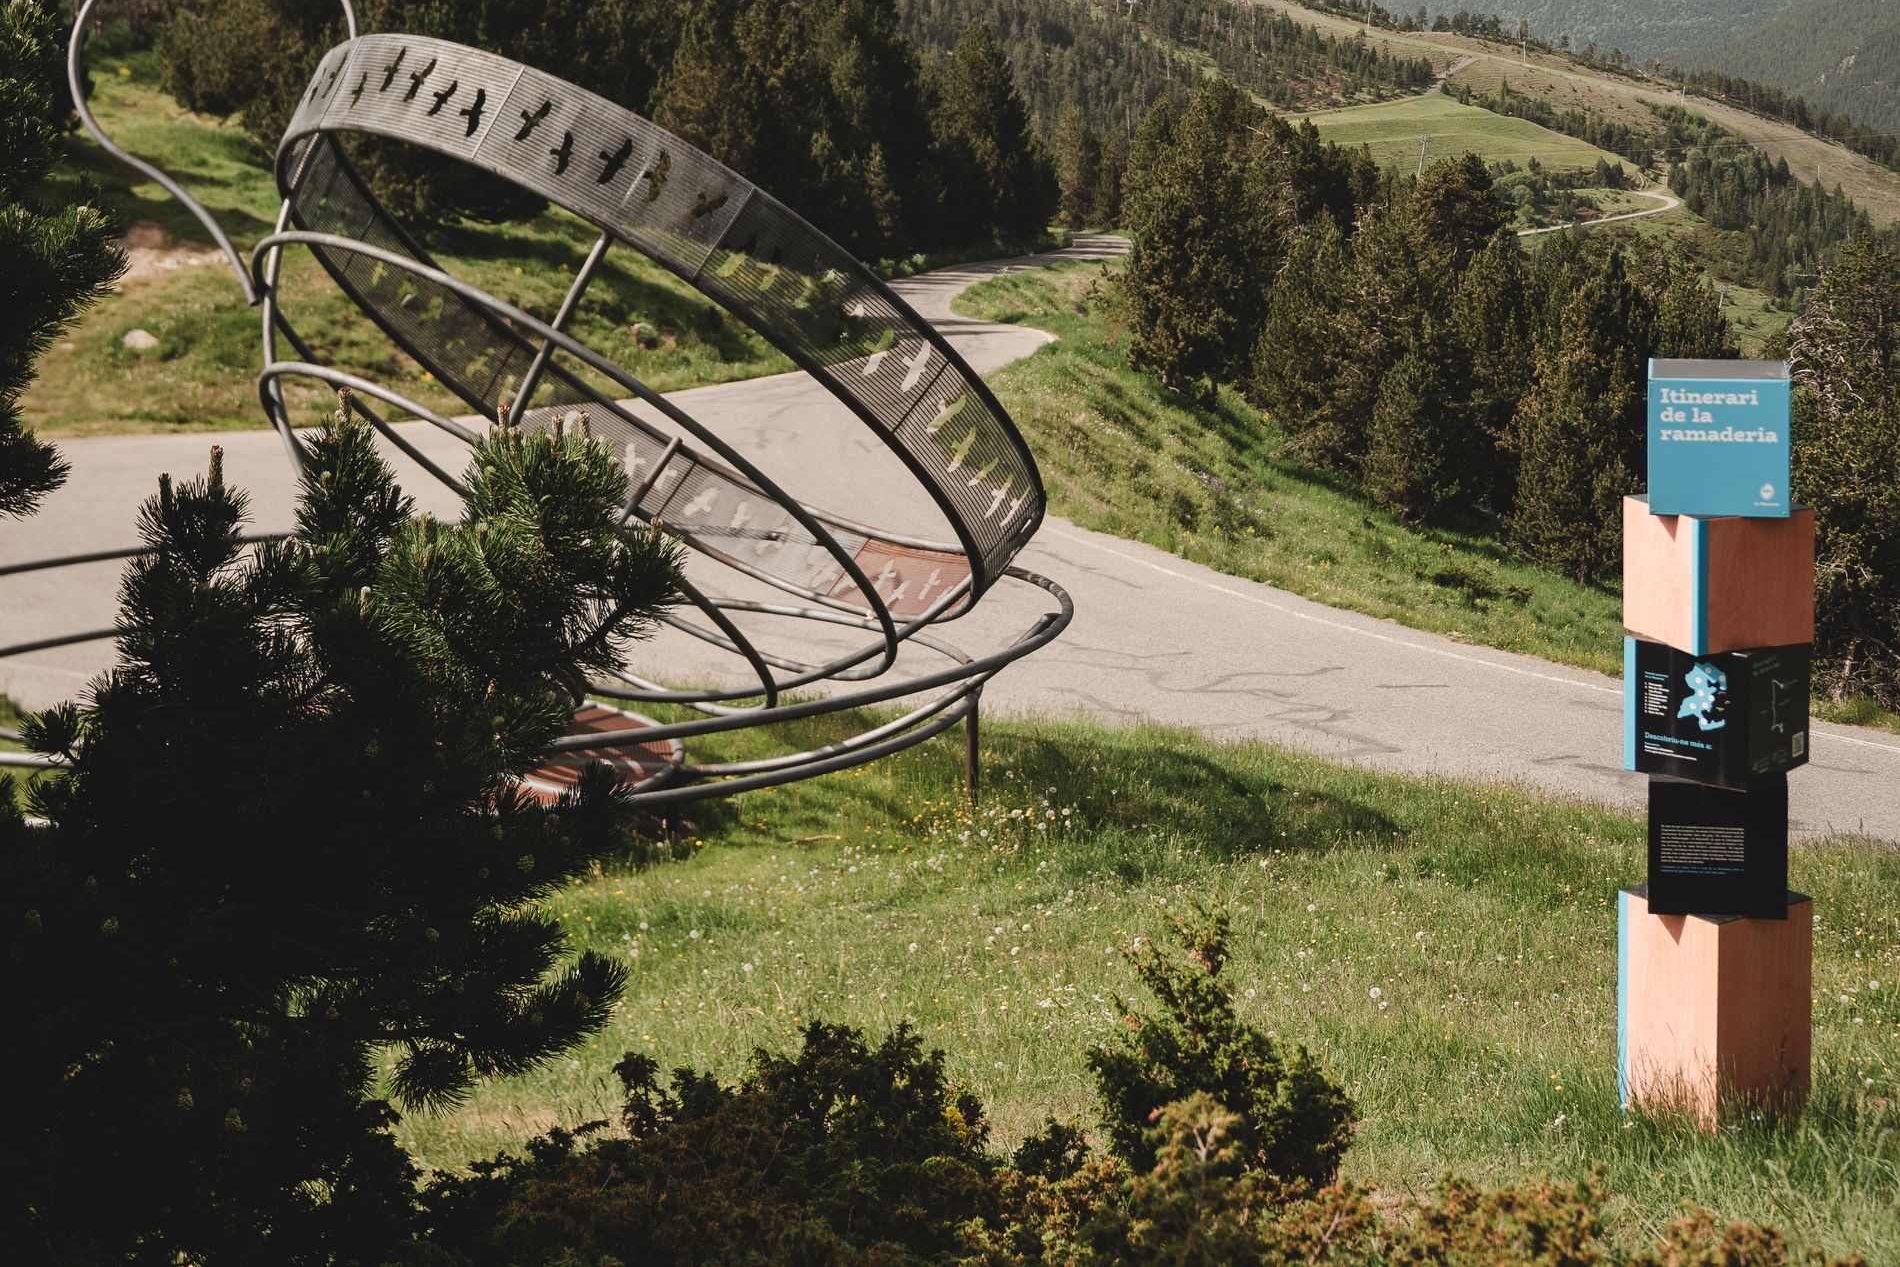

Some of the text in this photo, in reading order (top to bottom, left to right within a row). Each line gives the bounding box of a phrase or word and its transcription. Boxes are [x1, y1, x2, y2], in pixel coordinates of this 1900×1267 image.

[1660, 388, 1759, 405] Itinerari
[1660, 407, 1713, 423] de la
[1660, 426, 1778, 443] ramaderia
